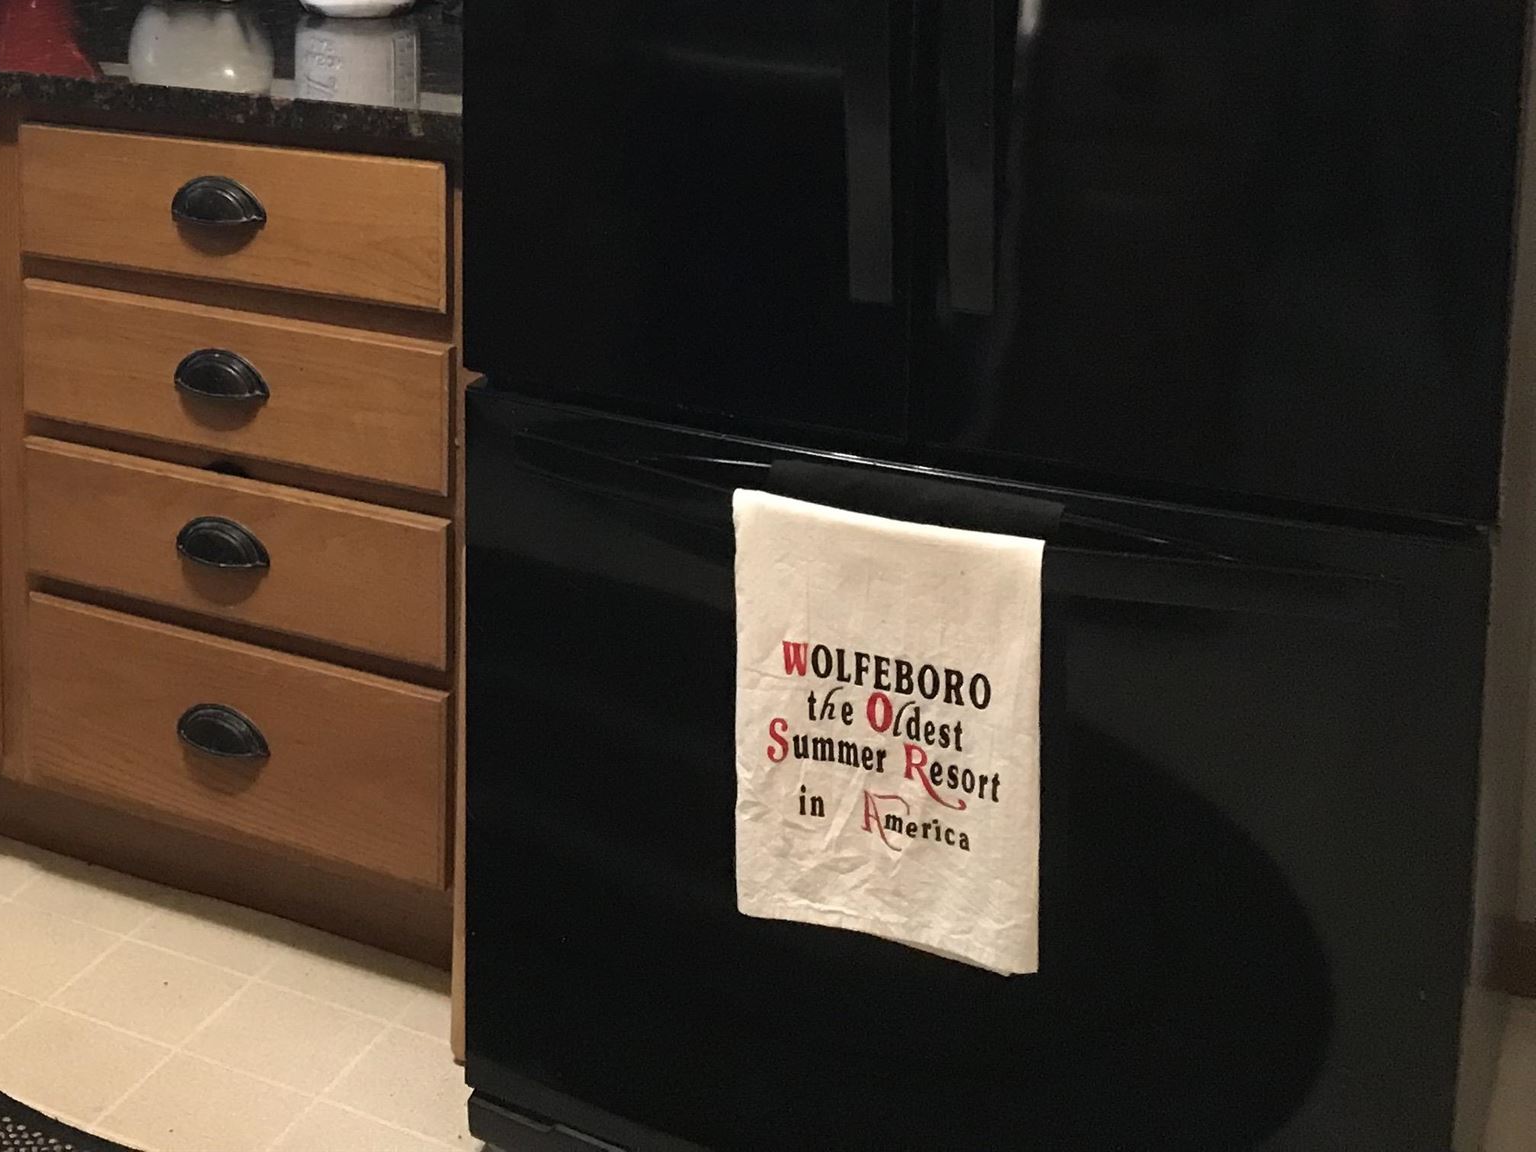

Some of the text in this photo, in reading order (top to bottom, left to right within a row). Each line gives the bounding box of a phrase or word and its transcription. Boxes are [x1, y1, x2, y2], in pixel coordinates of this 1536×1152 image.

[783, 641, 992, 710] WOLFEBORO
[807, 687, 963, 752] the Oldest
[767, 717, 1001, 810] Summer Resort
[798, 785, 971, 852] in America
